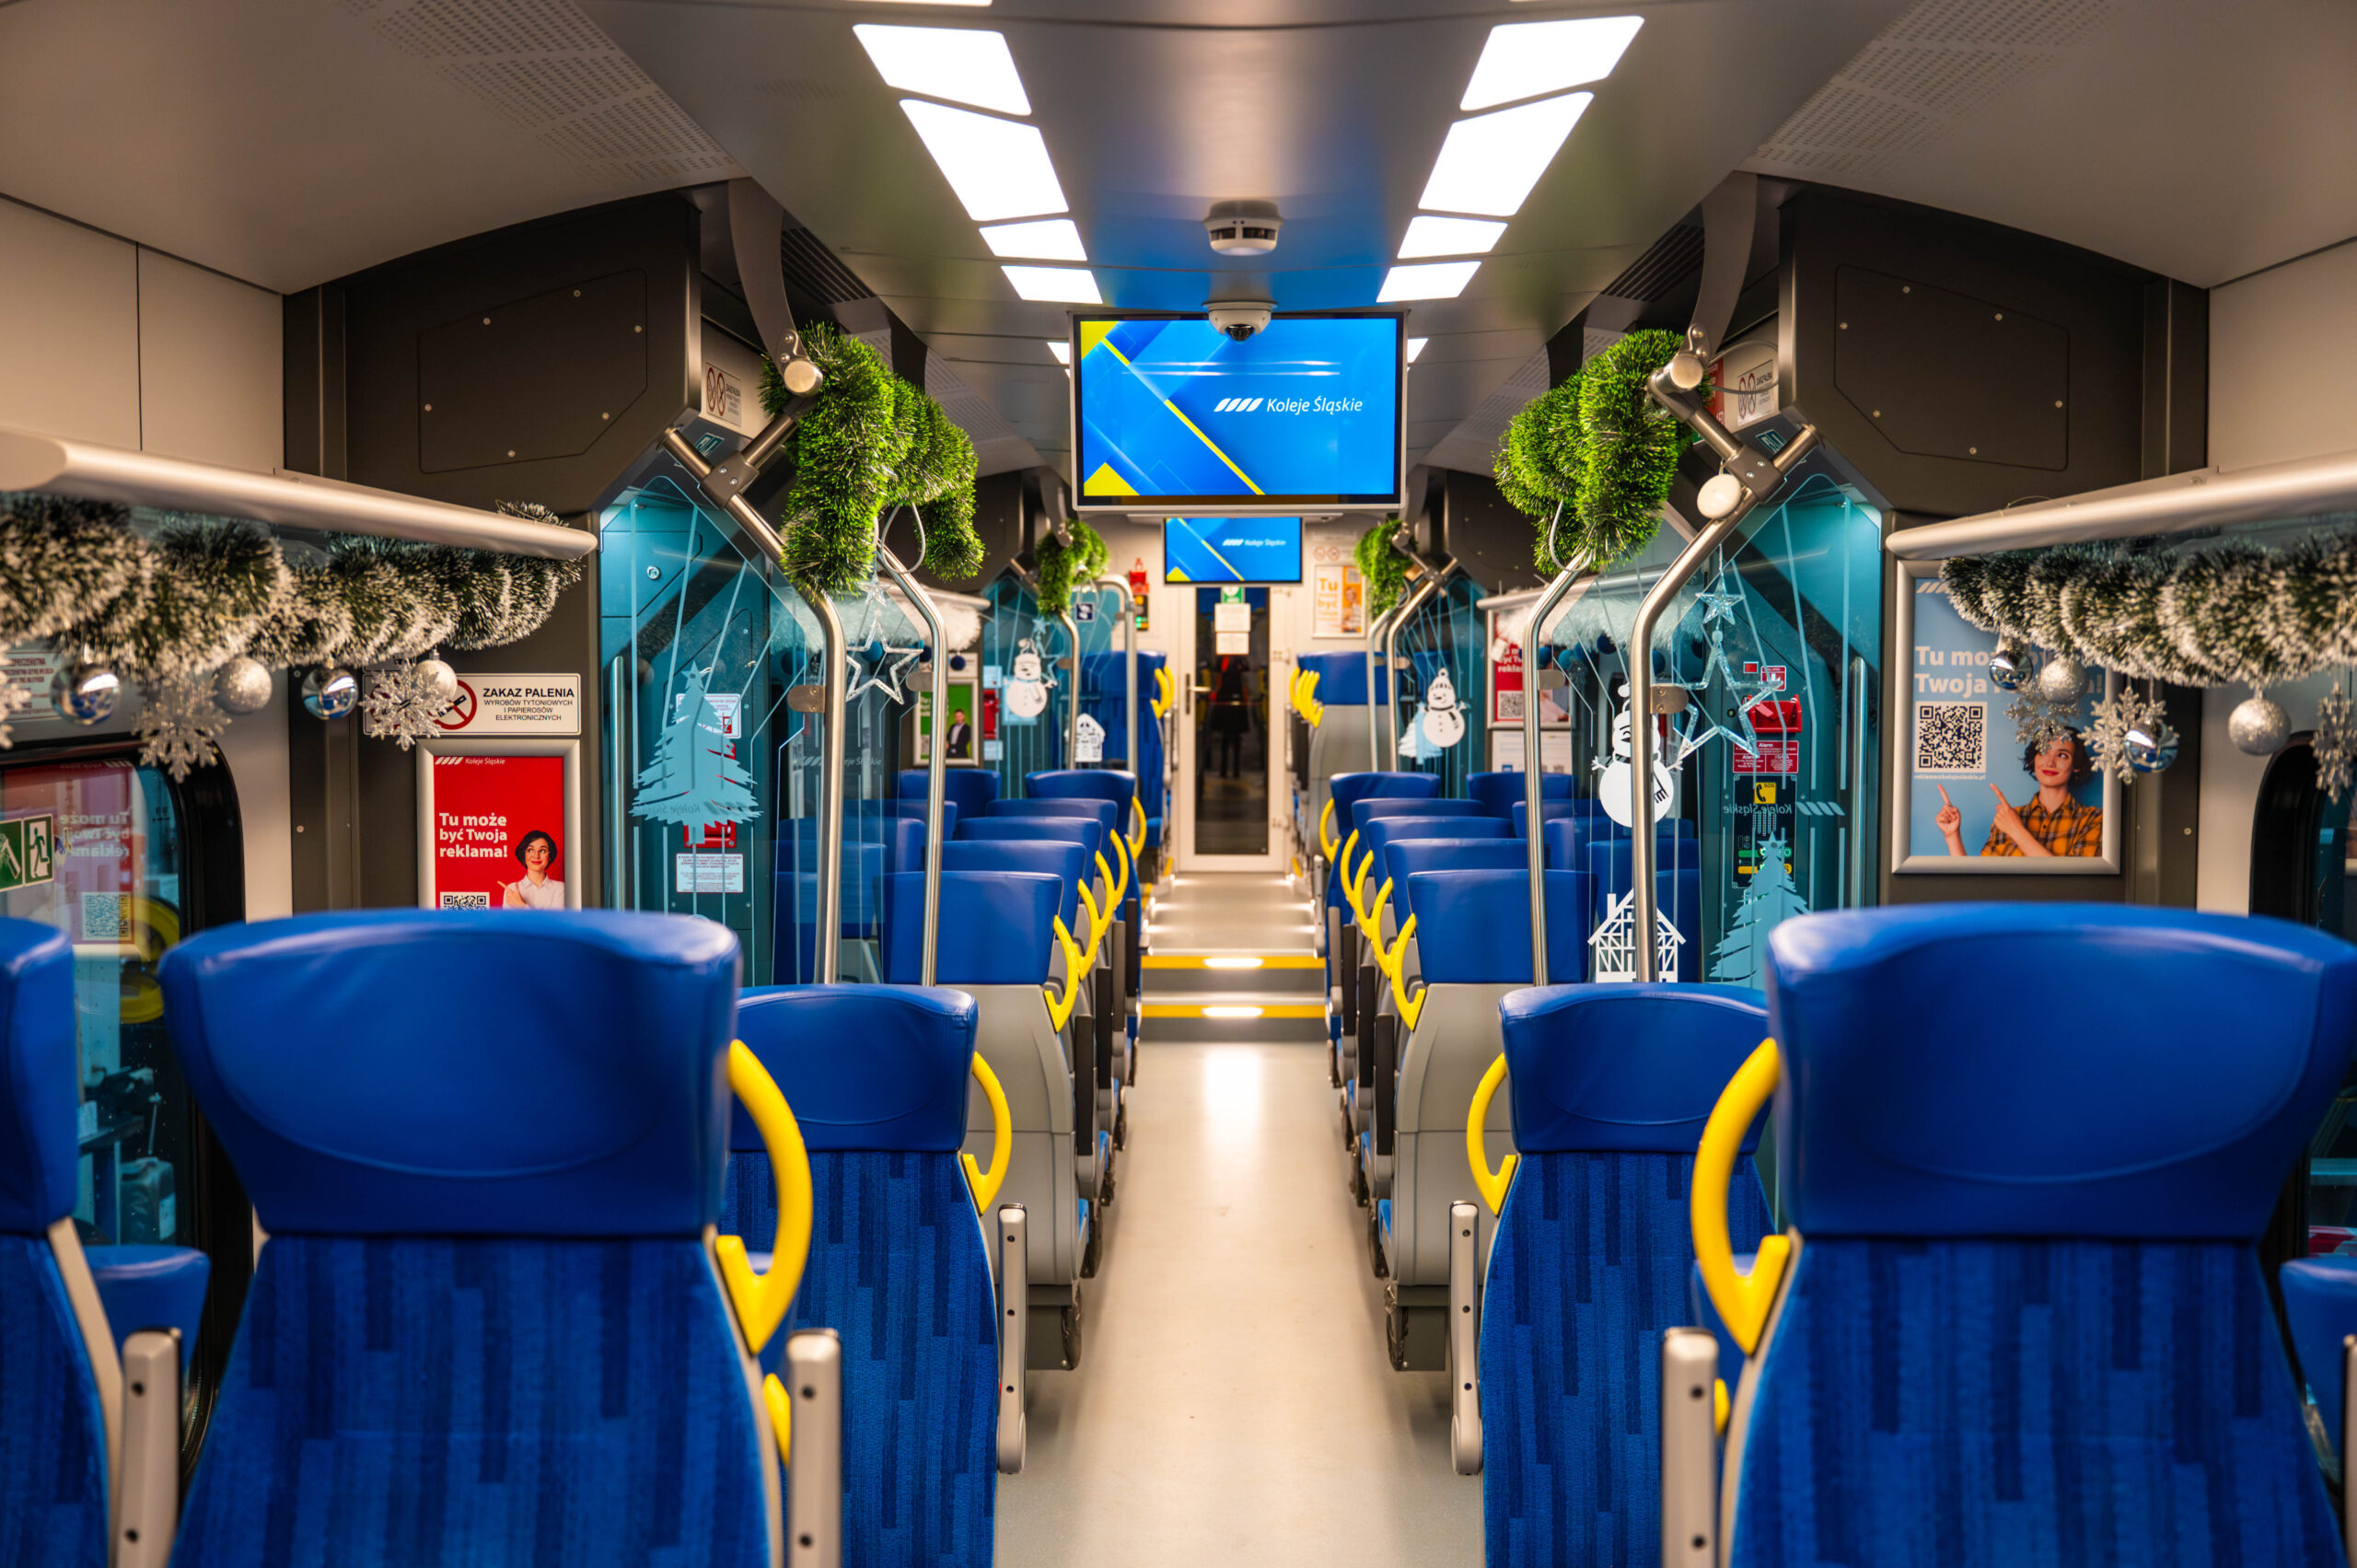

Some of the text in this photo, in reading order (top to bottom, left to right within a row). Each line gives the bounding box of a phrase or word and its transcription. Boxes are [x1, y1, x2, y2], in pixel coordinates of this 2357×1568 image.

[1267, 395, 1363, 415] Koleje Śląskie
[1318, 577, 1338, 590] Tu
[1915, 646, 1944, 666] Tu
[482, 688, 575, 697] ZAKAZ PALENIA
[1914, 672, 1988, 699] Twoja
[484, 757, 505, 765] Śląskie
[439, 812, 506, 826] Tu może
[439, 829, 507, 843] być Twoja
[439, 844, 507, 857] reklama!
